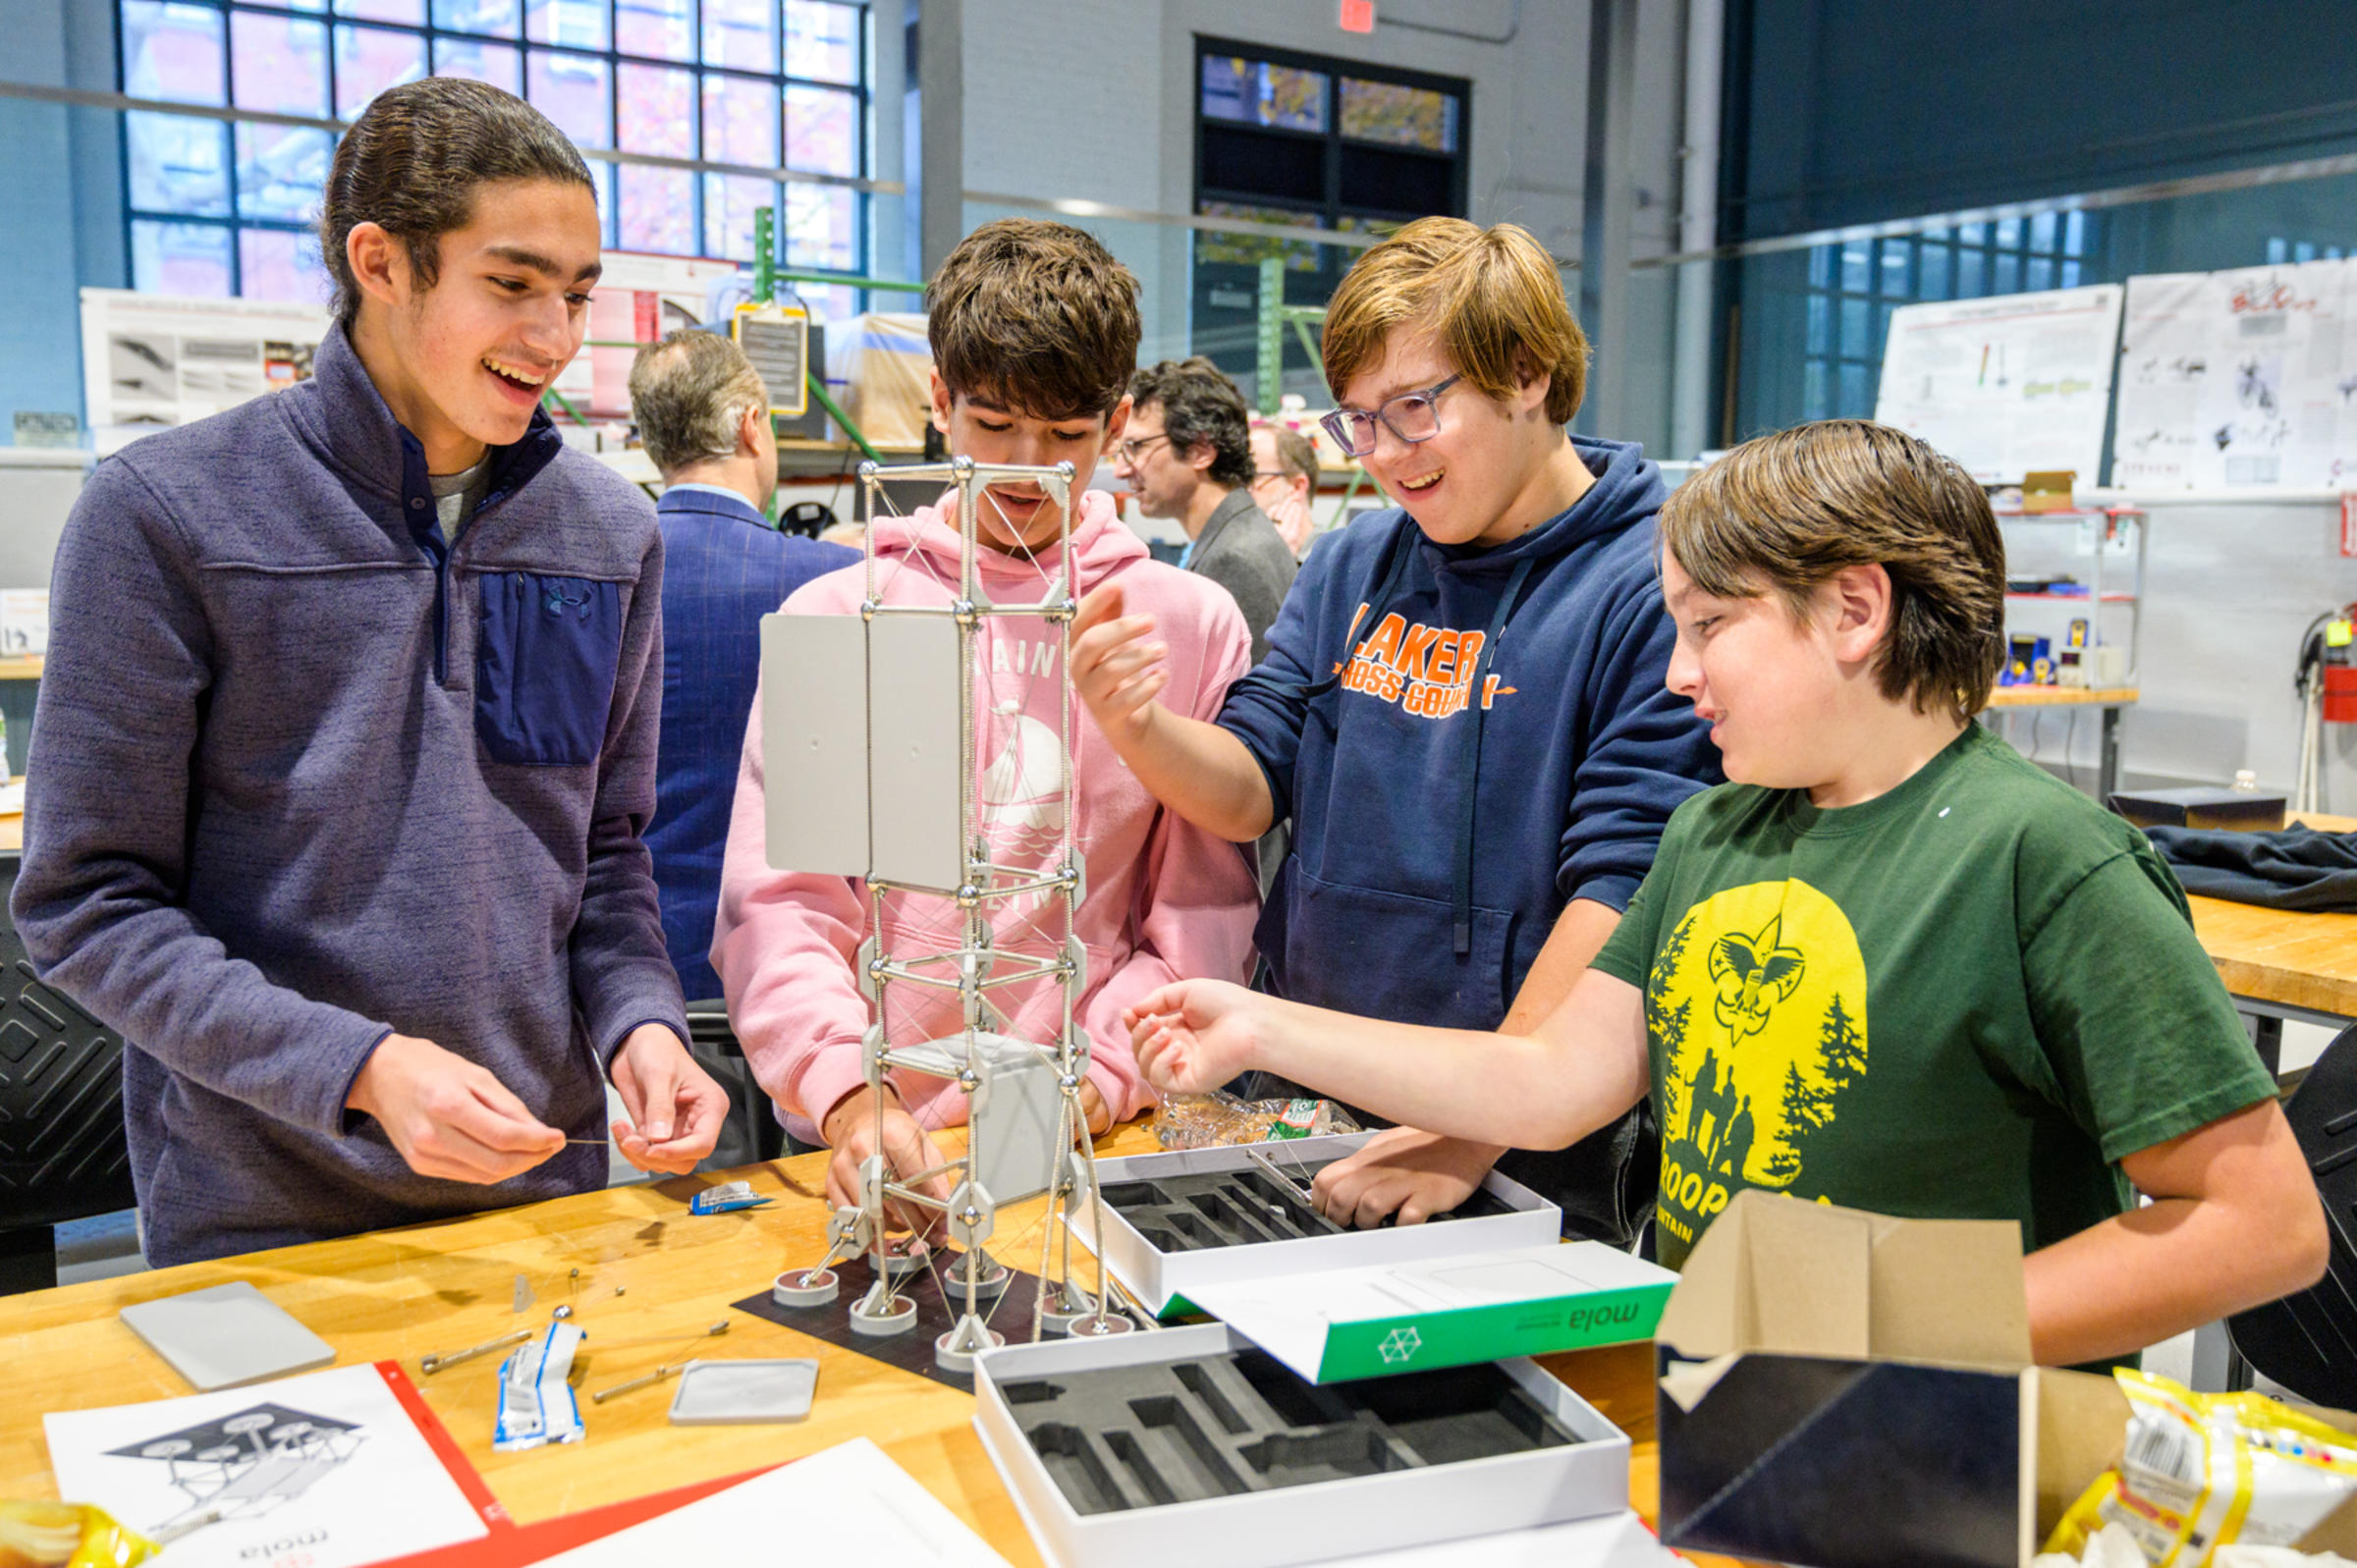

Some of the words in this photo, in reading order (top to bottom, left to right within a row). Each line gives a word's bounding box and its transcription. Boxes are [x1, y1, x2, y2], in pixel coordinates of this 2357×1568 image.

[1341, 656, 1404, 703] ROSS
[1659, 1152, 1728, 1217] ROOP
[1568, 1302, 1639, 1333] mola
[241, 1529, 328, 1558] mola
